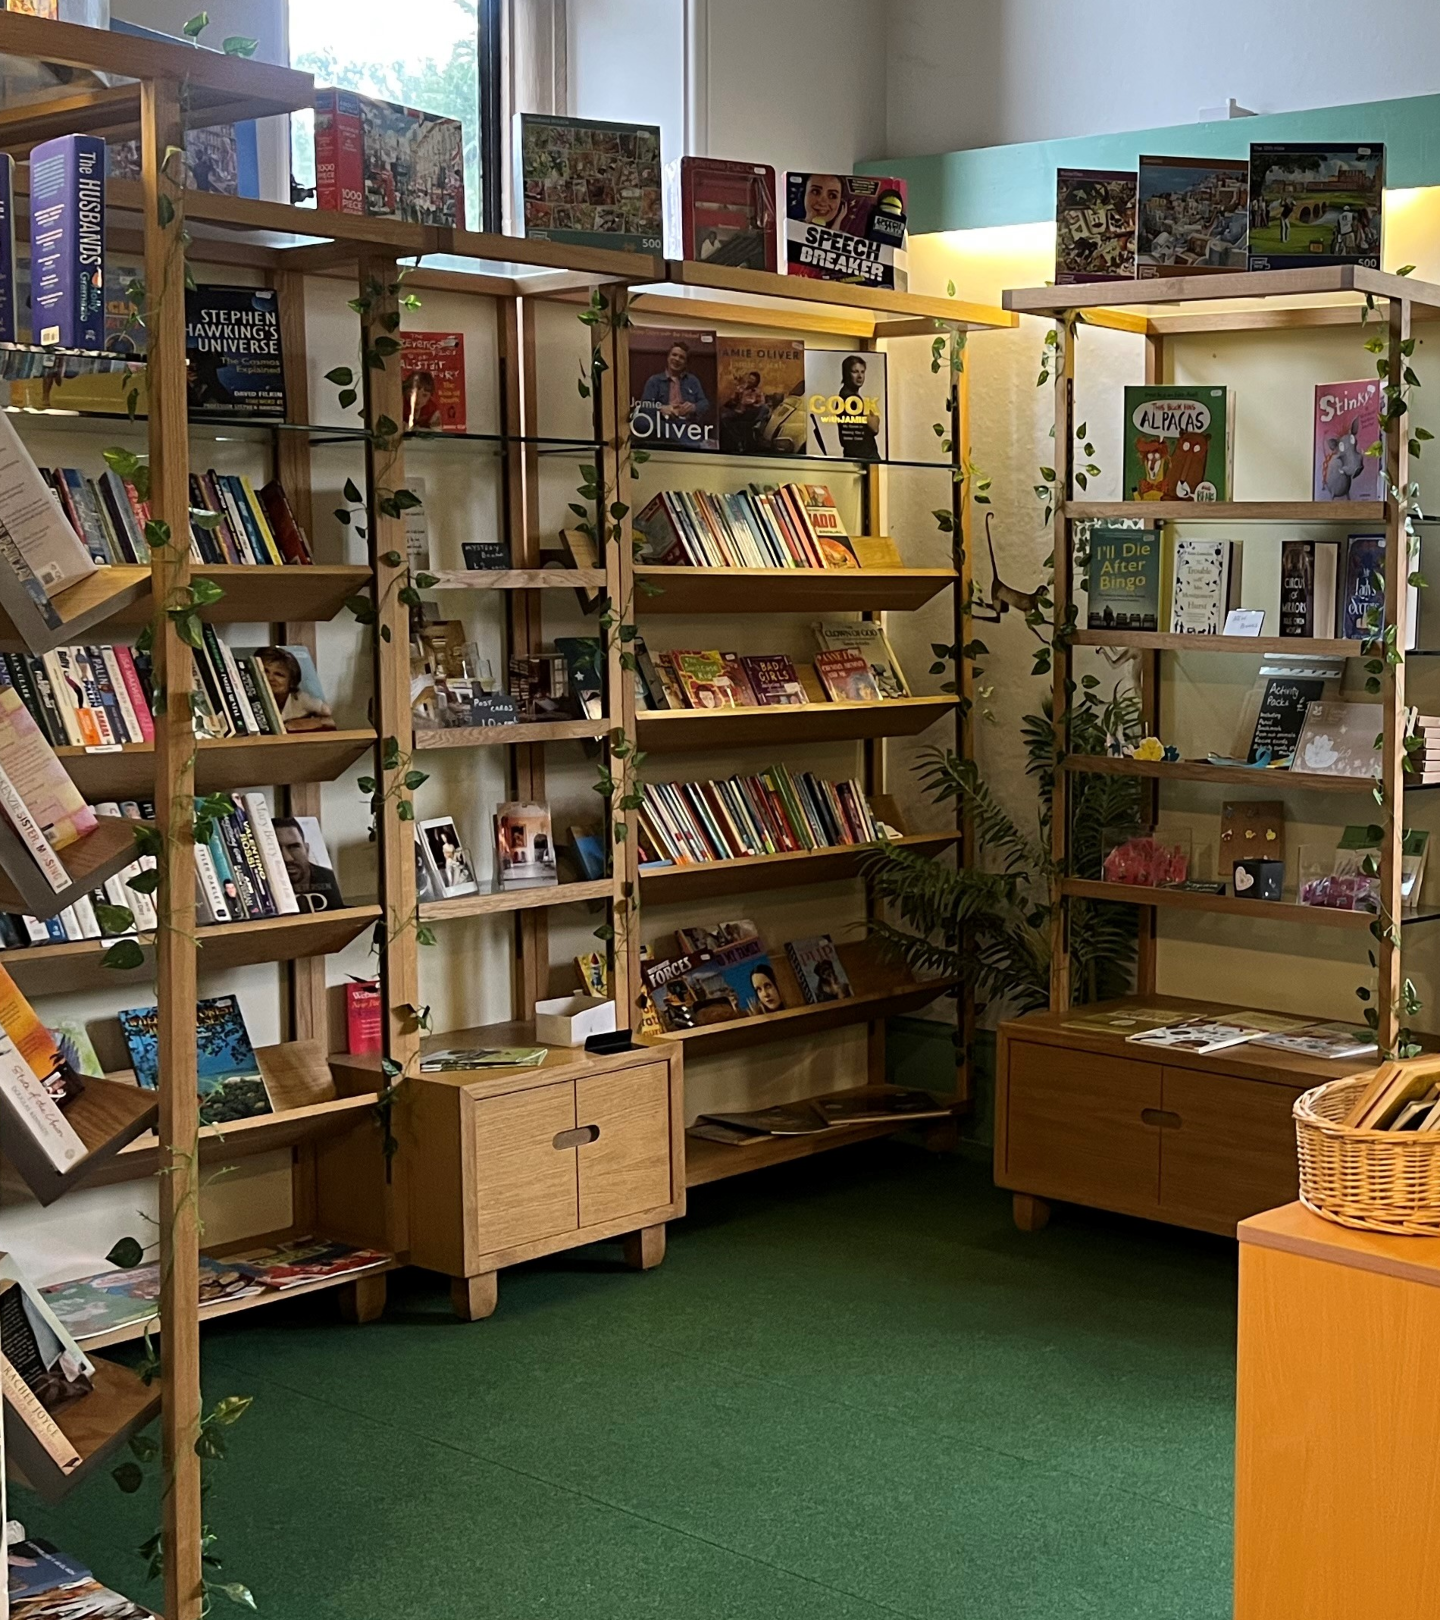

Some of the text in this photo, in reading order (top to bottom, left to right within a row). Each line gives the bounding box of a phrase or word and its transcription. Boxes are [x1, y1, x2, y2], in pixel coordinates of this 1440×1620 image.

[341, 189, 362, 201] 1000
[79, 152, 102, 266] The HUSBANDS
[342, 199, 363, 210] PIECE
[642, 238, 661, 249] 500
[805, 227, 881, 261] SPEECH
[800, 246, 884, 281] BREAKER
[1358, 259, 1377, 268] 500
[201, 309, 277, 325] STEPHEN
[185, 323, 278, 340] HAWKING'S
[198, 338, 279, 354] UNIVERSE
[220, 357, 280, 366] The Cosmos
[757, 350, 799, 361] OLIVER
[236, 366, 281, 375] Explained
[629, 397, 662, 409] Jamie
[809, 394, 880, 416] COOK
[630, 409, 714, 440] Oliver
[821, 415, 868, 424] with JAMIE
[1140, 410, 1204, 431] ALPACAS
[1097, 543, 1151, 560] I'll Die
[1100, 559, 1146, 575] After
[1187, 567, 1212, 575] Trouble
[1100, 576, 1146, 591] Bingo
[1284, 577, 1305, 589] CIRCUS
[1282, 602, 1307, 614] MIRRORS
[824, 629, 852, 638] CLOWN
[91, 656, 110, 686] PALIN
[760, 661, 779, 672] BAD
[758, 670, 789, 682] GIRLS
[81, 679, 98, 709] PALIN
[1269, 682, 1299, 700] Activity
[1267, 696, 1289, 707] Packs
[252, 800, 271, 829] Mary
[239, 832, 256, 869] ROSSI
[243, 820, 267, 881] VALENTINO
[261, 829, 279, 859] Berry
[35, 843, 65, 881] MISSING
[198, 848, 222, 906] TYLER OAKLEY
[648, 956, 693, 988] FORCES
[2, 1365, 61, 1439] RACHEL JOYCE
